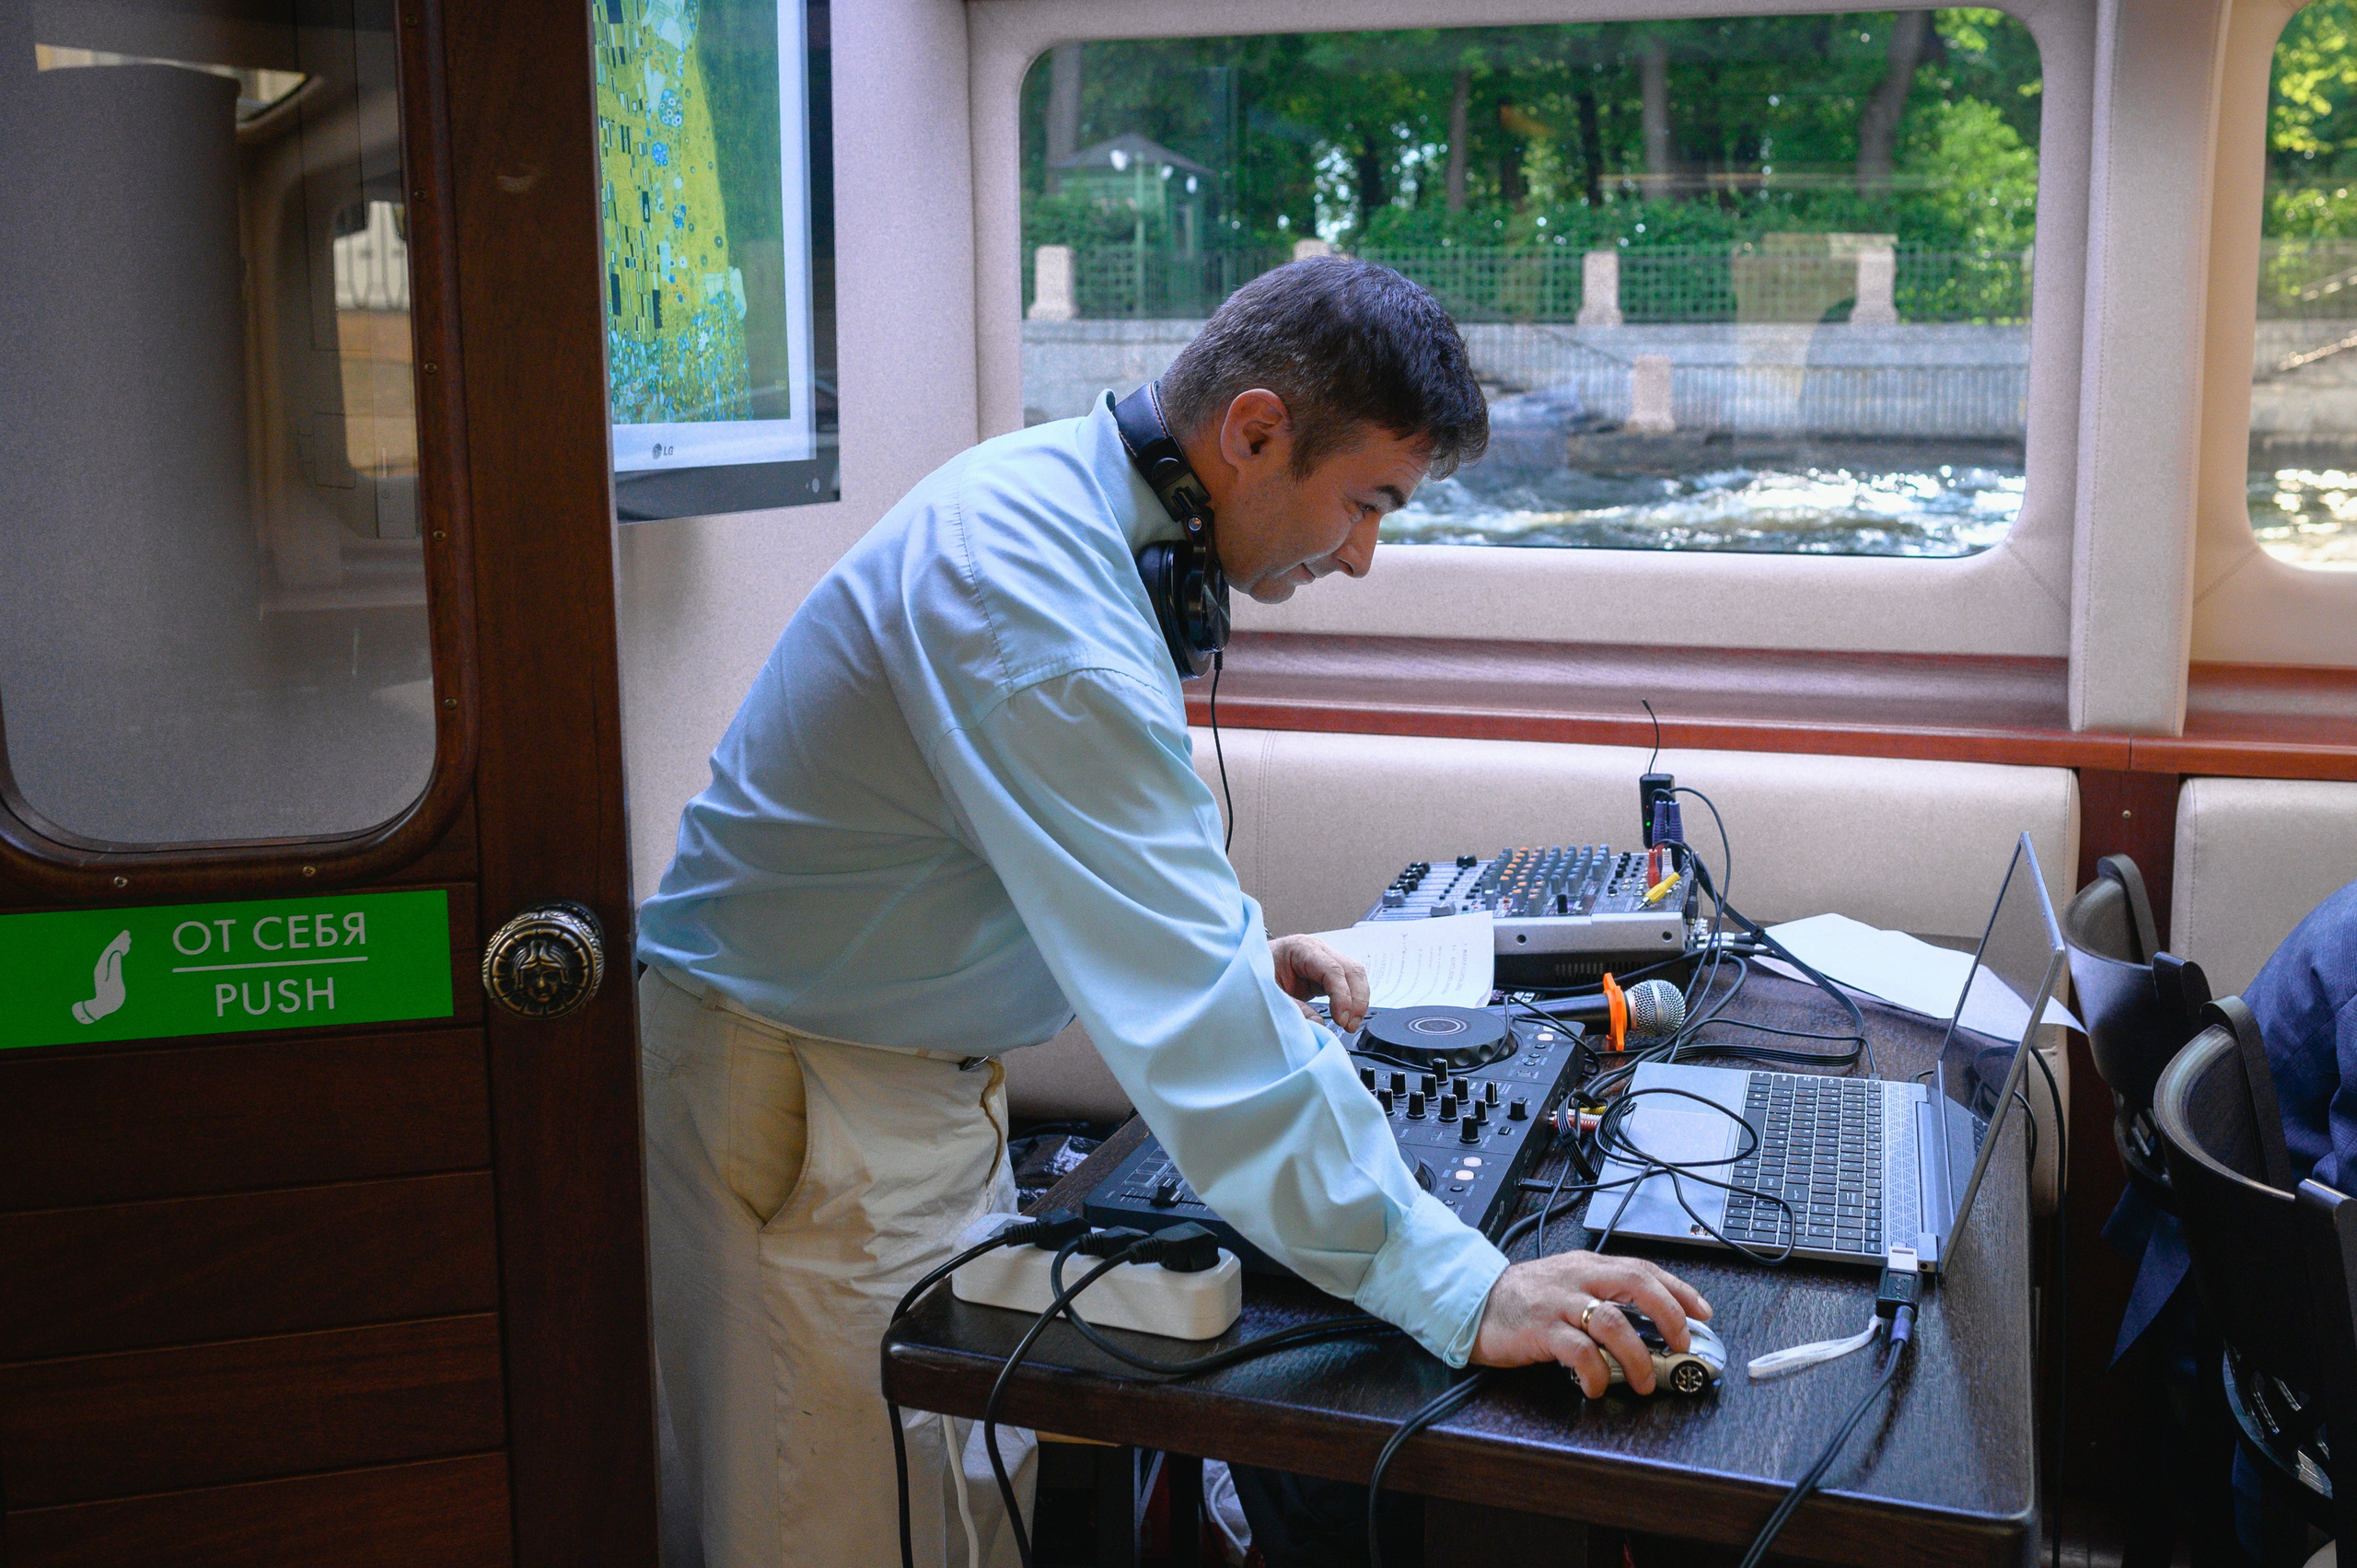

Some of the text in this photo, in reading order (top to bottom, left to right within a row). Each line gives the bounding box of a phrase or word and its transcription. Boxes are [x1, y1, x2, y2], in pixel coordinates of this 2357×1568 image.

[663, 446, 674, 456] LG
[172, 912, 366, 956] ОТ СЕБЯ
[215, 977, 335, 1017] PUSH
